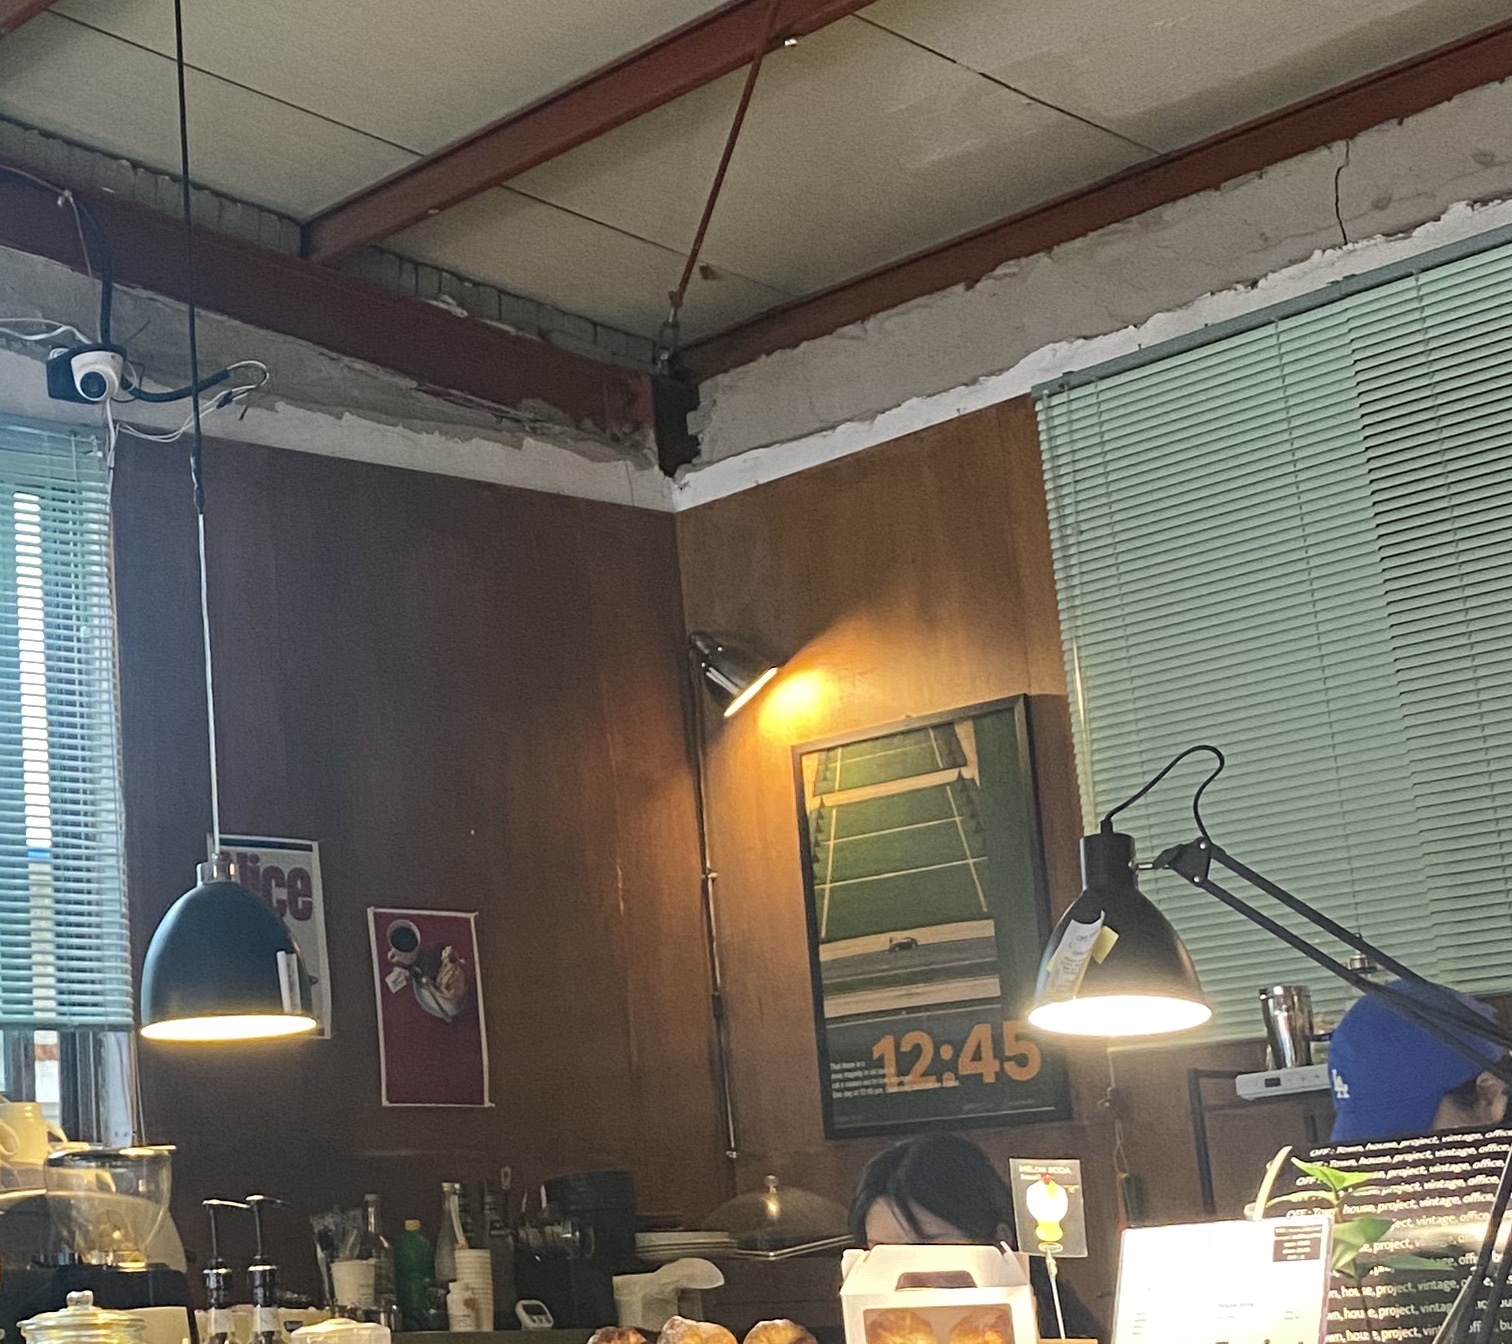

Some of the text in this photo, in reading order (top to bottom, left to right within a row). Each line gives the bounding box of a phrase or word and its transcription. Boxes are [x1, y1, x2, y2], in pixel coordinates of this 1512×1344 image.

[872, 1021, 1041, 1093] 12:45
[1435, 1146, 1478, 1158] vintage,
[1429, 1162, 1472, 1174] vintage,
[1423, 1178, 1467, 1190] vintage,
[1419, 1196, 1463, 1208] vintage,
[1417, 1279, 1460, 1293] vintage,
